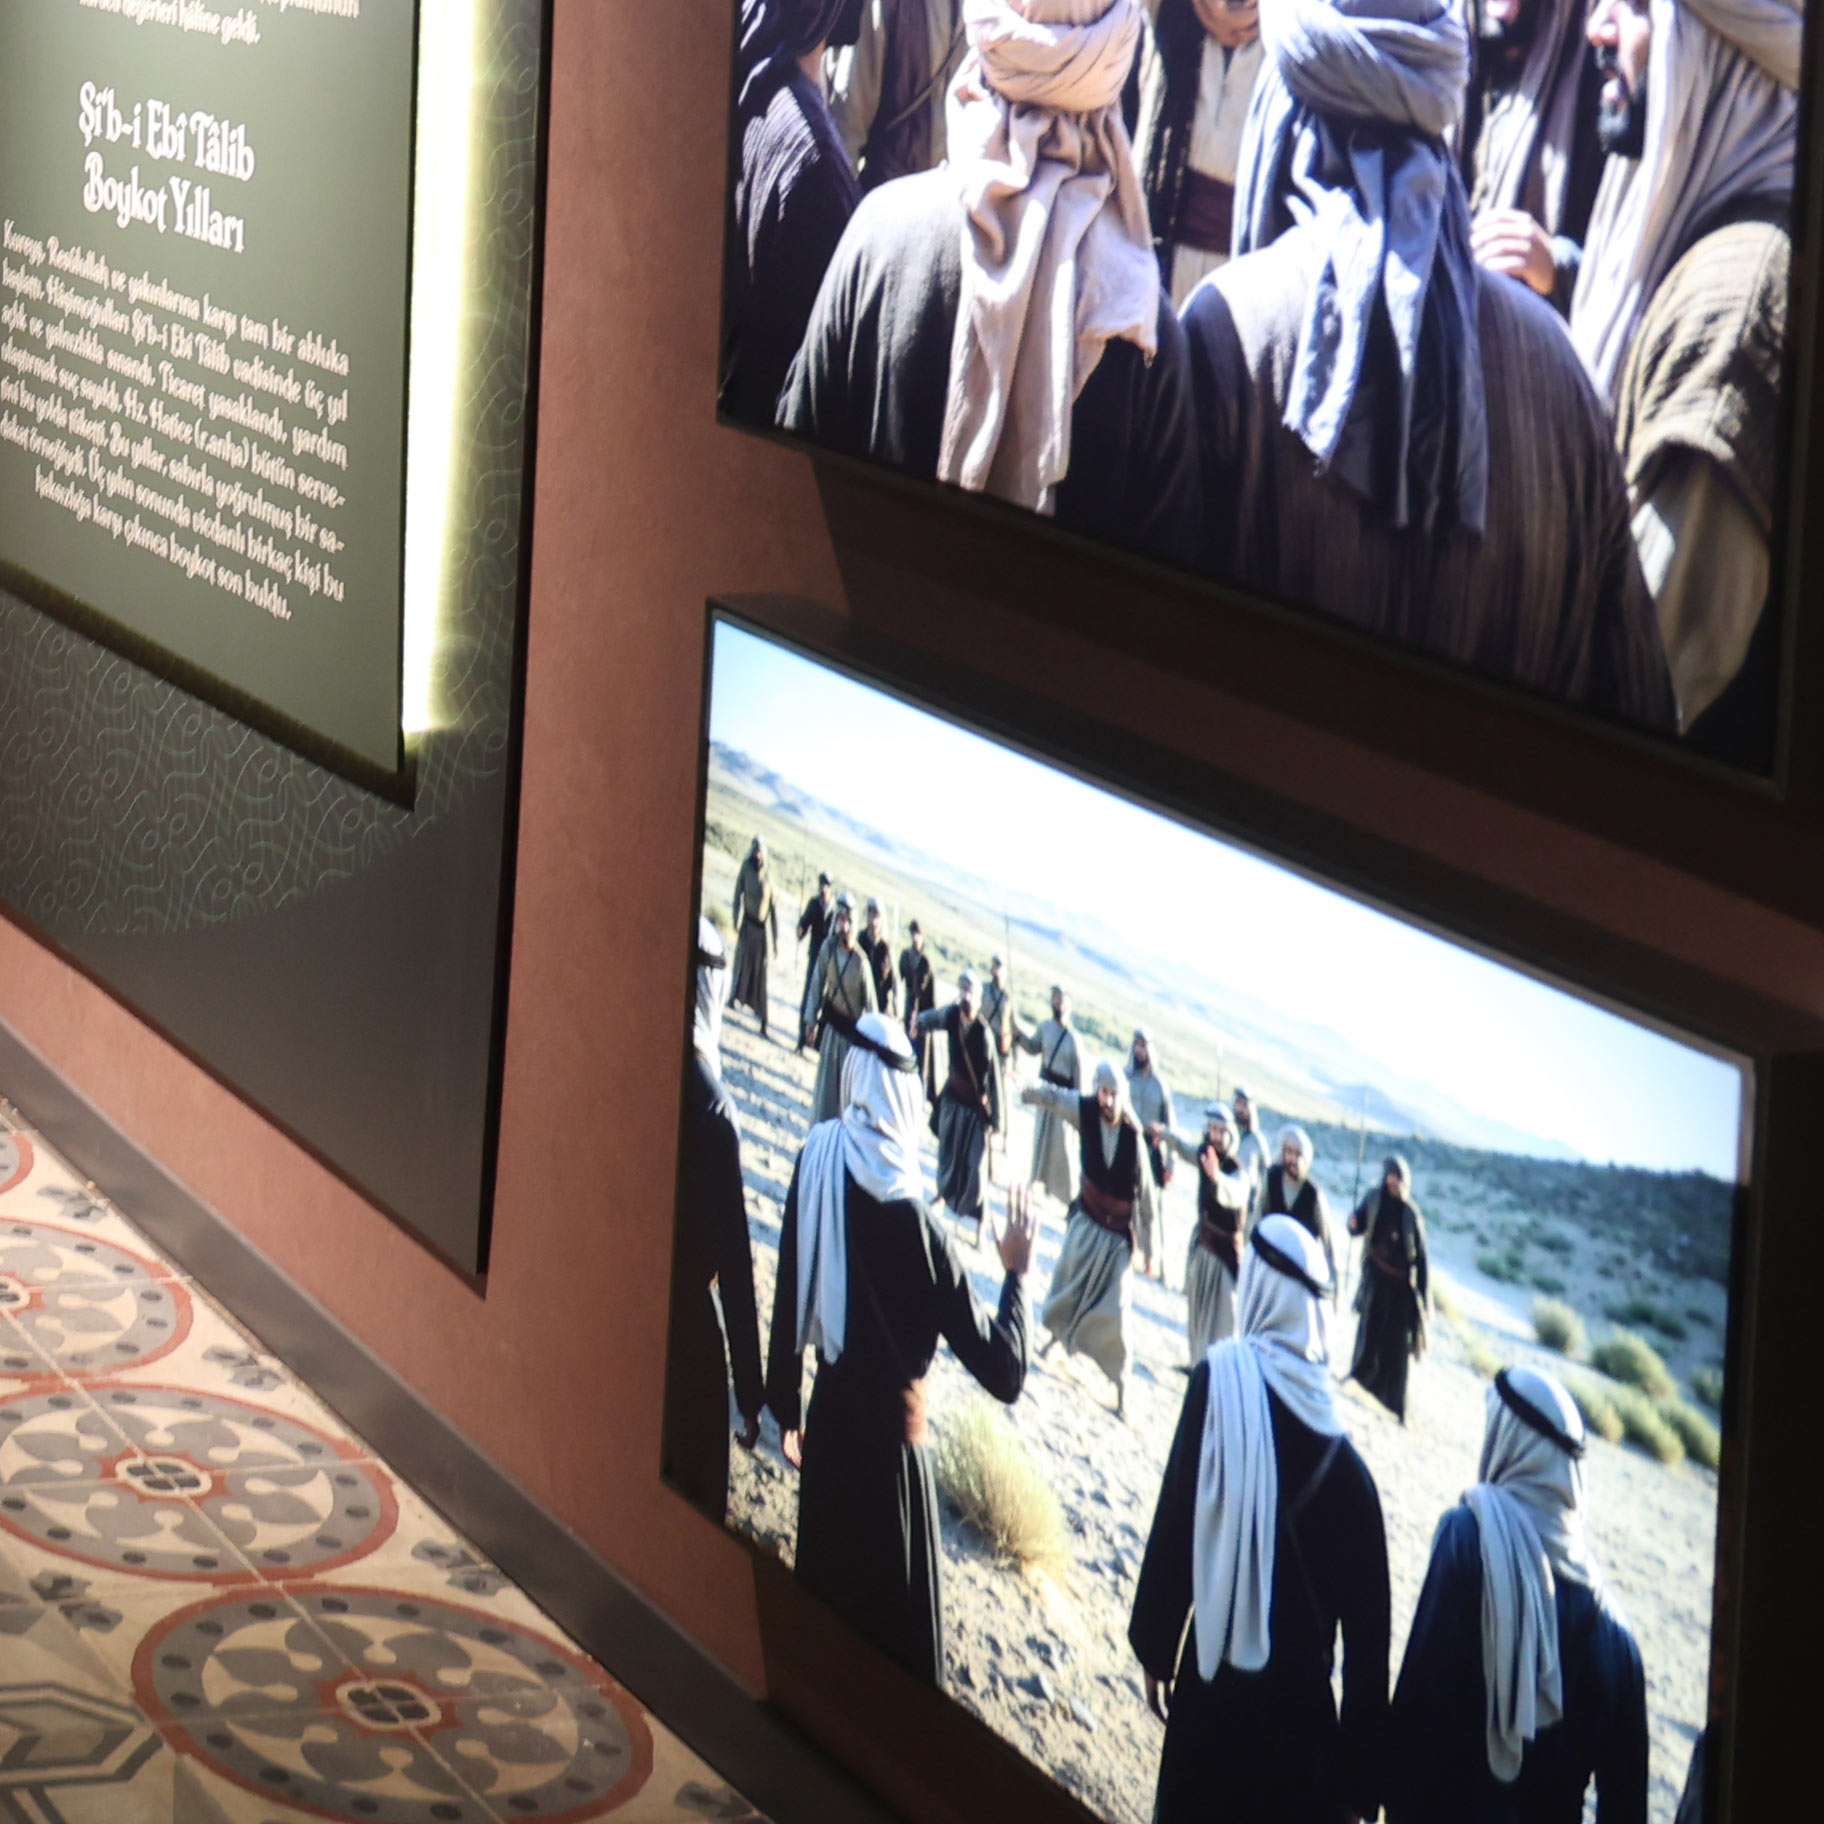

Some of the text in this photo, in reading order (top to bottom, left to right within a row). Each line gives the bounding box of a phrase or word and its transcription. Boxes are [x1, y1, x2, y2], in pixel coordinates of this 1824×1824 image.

[145, 98, 188, 163] Ebî
[189, 110, 255, 182] Tâlib
[83, 151, 245, 254] Boykot Yılları
[110, 269, 127, 293] ve
[128, 270, 200, 321] yakınlarına
[202, 292, 238, 341] karşı
[240, 313, 270, 350] tam
[271, 317, 296, 355] bir
[297, 330, 349, 377] abluka
[29, 316, 44, 339] ve
[158, 359, 206, 411] Ticaret
[208, 391, 288, 445] yasaklandı,
[292, 426, 348, 471] yardım
[58, 367, 80, 400] suç
[123, 386, 149, 425] Hz.
[148, 397, 194, 445] Hatice
[250, 441, 296, 491] bütün
[297, 472, 346, 509] serve-
[232, 355, 302, 404] vadisinde
[304, 379, 325, 420] üç
[326, 388, 348, 426] yıl
[19, 379, 36, 413] bu
[35, 393, 68, 428] yolda
[109, 421, 130, 458] Bu
[168, 453, 215, 497] sabırla
[215, 480, 294, 541] yoğrulmuş
[294, 504, 319, 544] bir
[319, 527, 345, 554] sa-
[92, 492, 292, 621] karşı çıkınca boykot son buldu.
[135, 484, 191, 529] sonunda
[192, 507, 246, 555] vicdanlı
[247, 526, 294, 585] birkaç
[294, 549, 322, 596] kişi
[322, 562, 345, 603] bu
